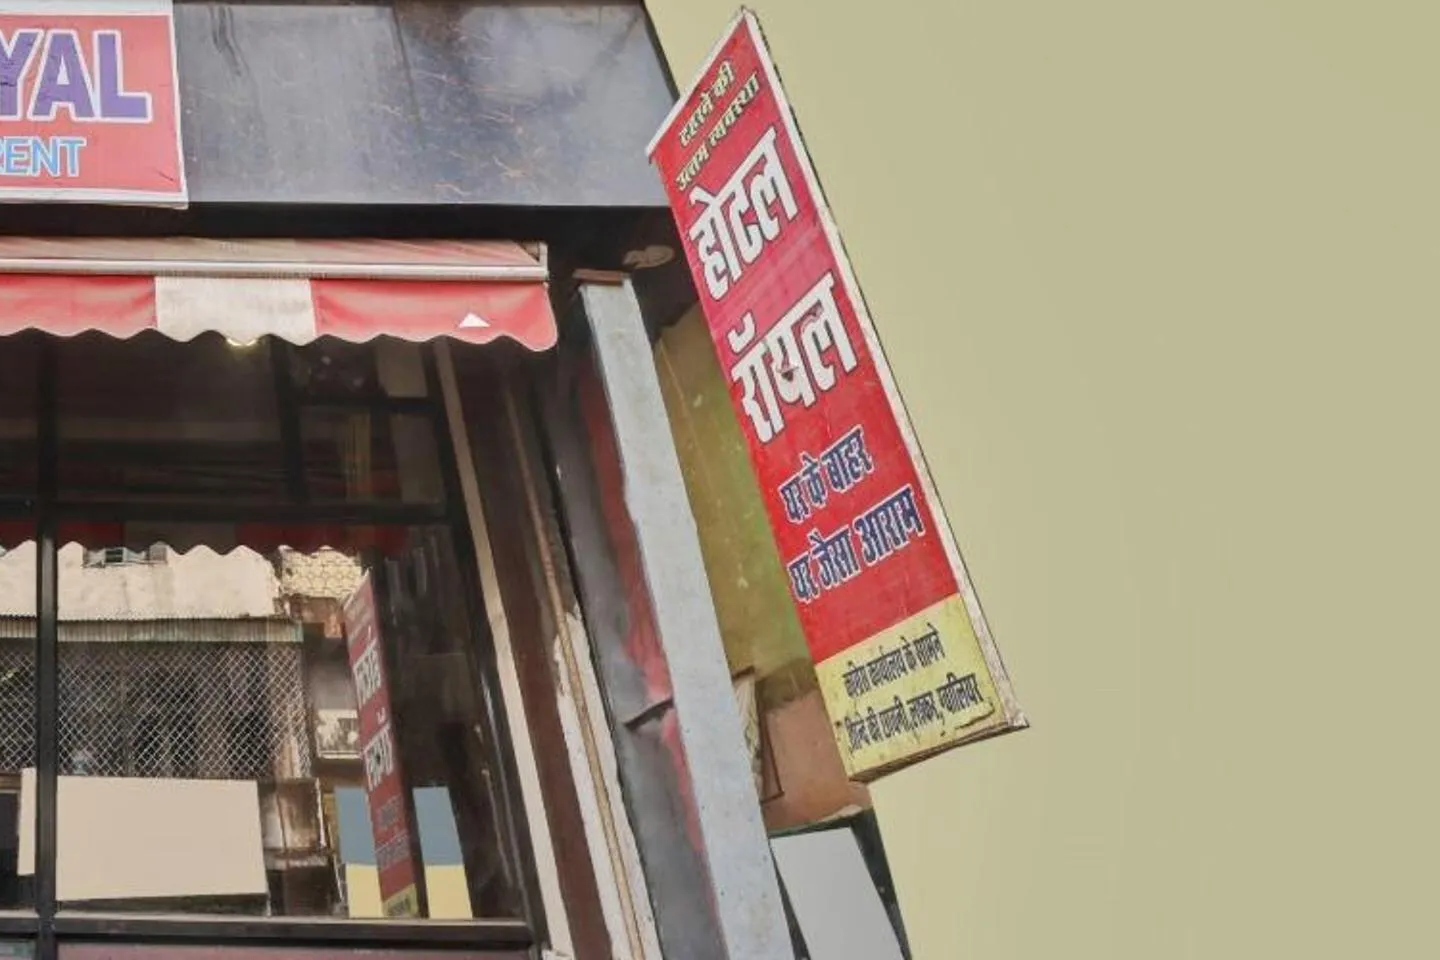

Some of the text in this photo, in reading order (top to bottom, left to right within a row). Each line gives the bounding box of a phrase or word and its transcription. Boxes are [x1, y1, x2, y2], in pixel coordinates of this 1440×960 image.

[689, 126, 799, 302] होटल
[728, 271, 859, 443] रॉयल
[777, 424, 875, 524] घर के बाहर
[786, 483, 926, 604] घर जैसा आराम
